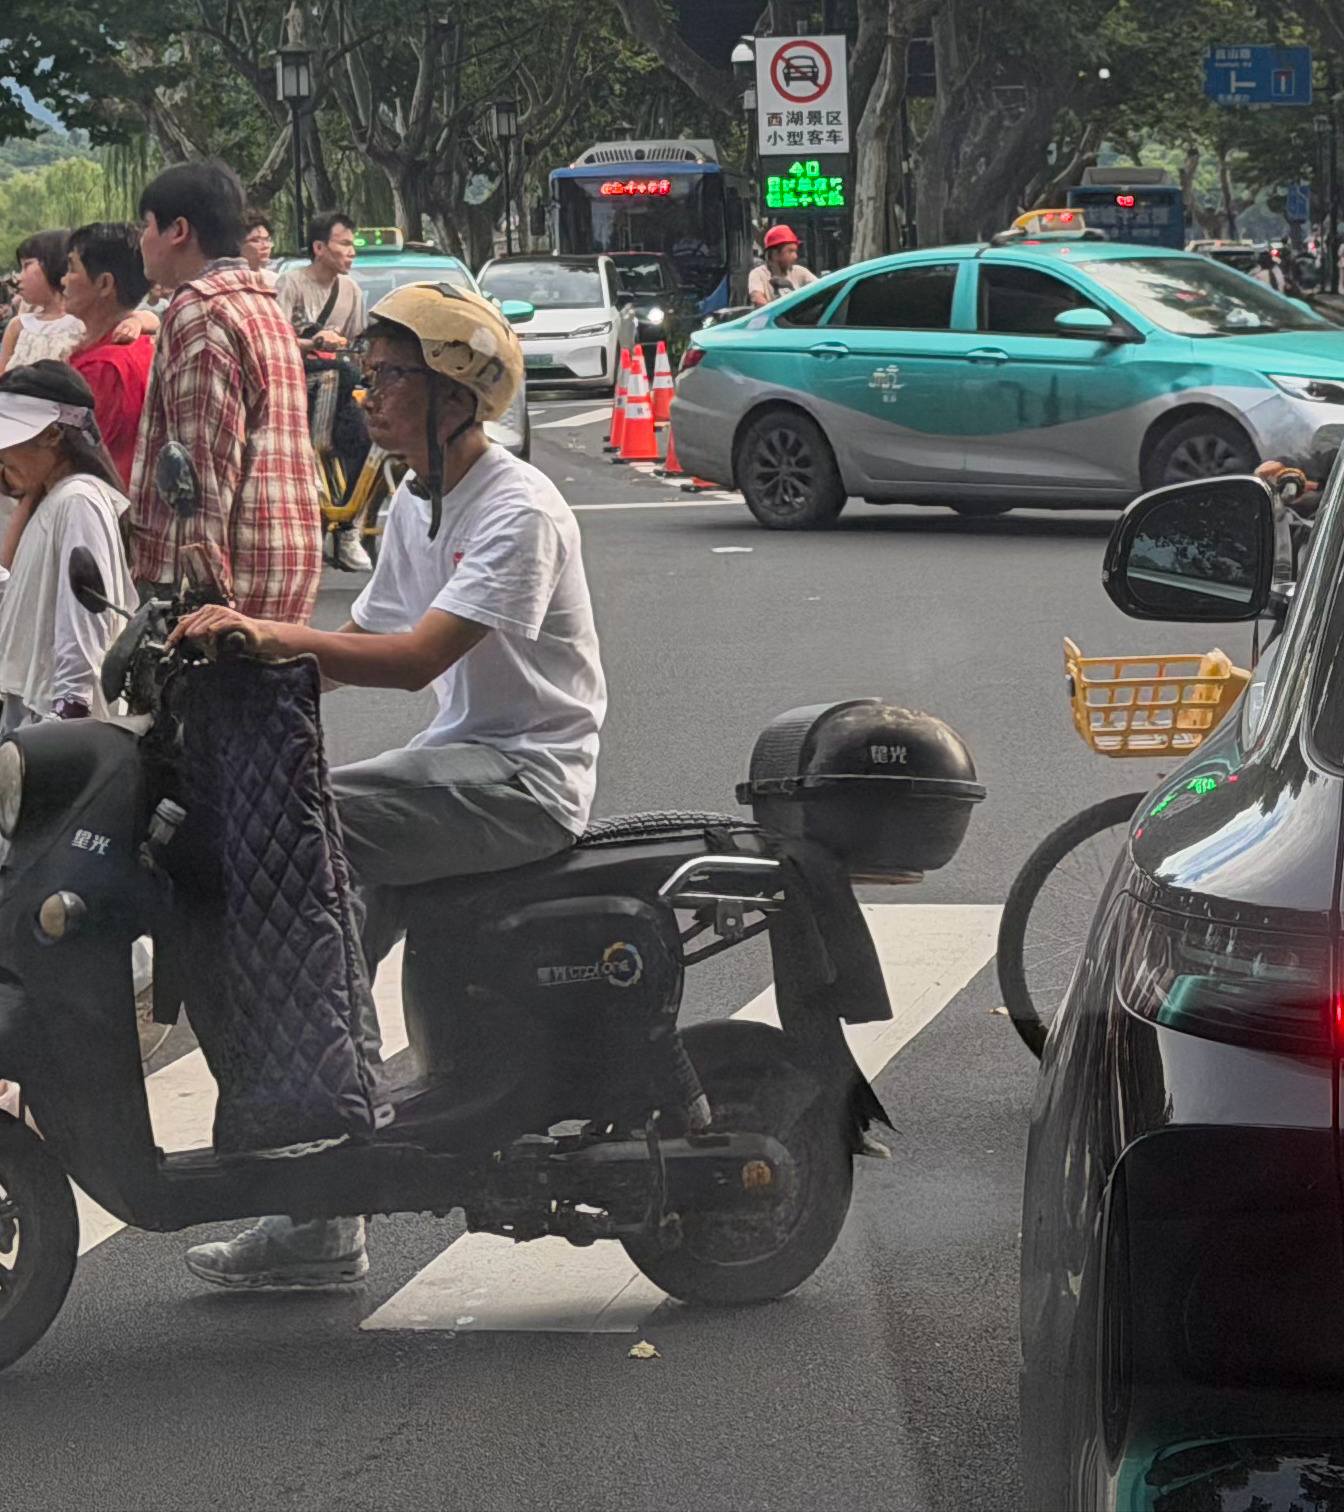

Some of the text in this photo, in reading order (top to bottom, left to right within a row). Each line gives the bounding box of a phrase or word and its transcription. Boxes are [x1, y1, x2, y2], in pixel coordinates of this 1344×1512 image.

[766, 111, 843, 127] 西湖景区
[767, 130, 844, 146] 小型客车
